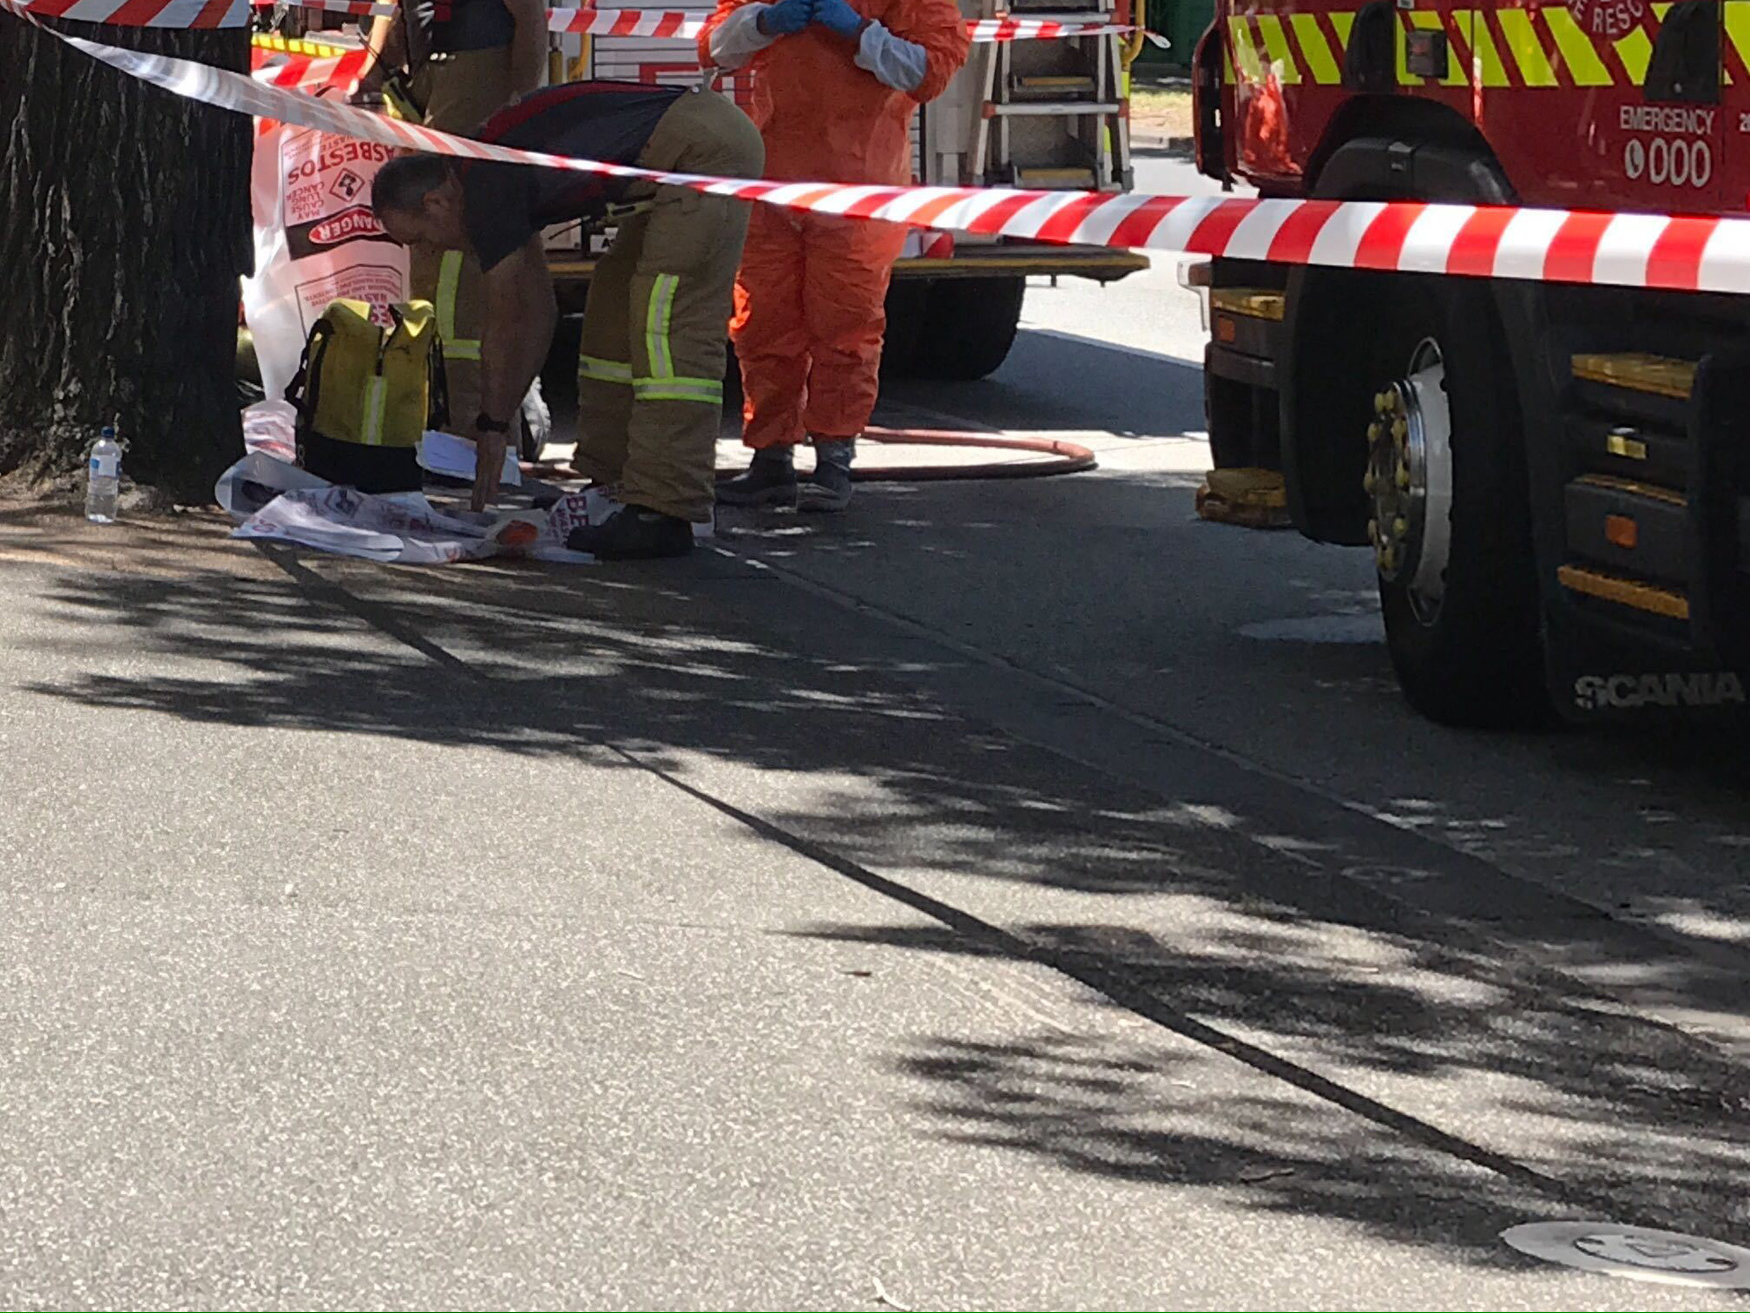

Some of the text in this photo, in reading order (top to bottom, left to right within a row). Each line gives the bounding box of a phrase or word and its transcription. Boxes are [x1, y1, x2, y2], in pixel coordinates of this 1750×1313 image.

[1619, 105, 1714, 135] EMERGENCY
[287, 141, 396, 186] ASBESTOS
[1649, 137, 1712, 188] 000
[286, 181, 325, 202] CANCER
[292, 191, 320, 206] LUNG
[291, 199, 325, 215] CAUSE
[297, 209, 320, 221] MAY
[1575, 673, 1746, 709] SCANIA
